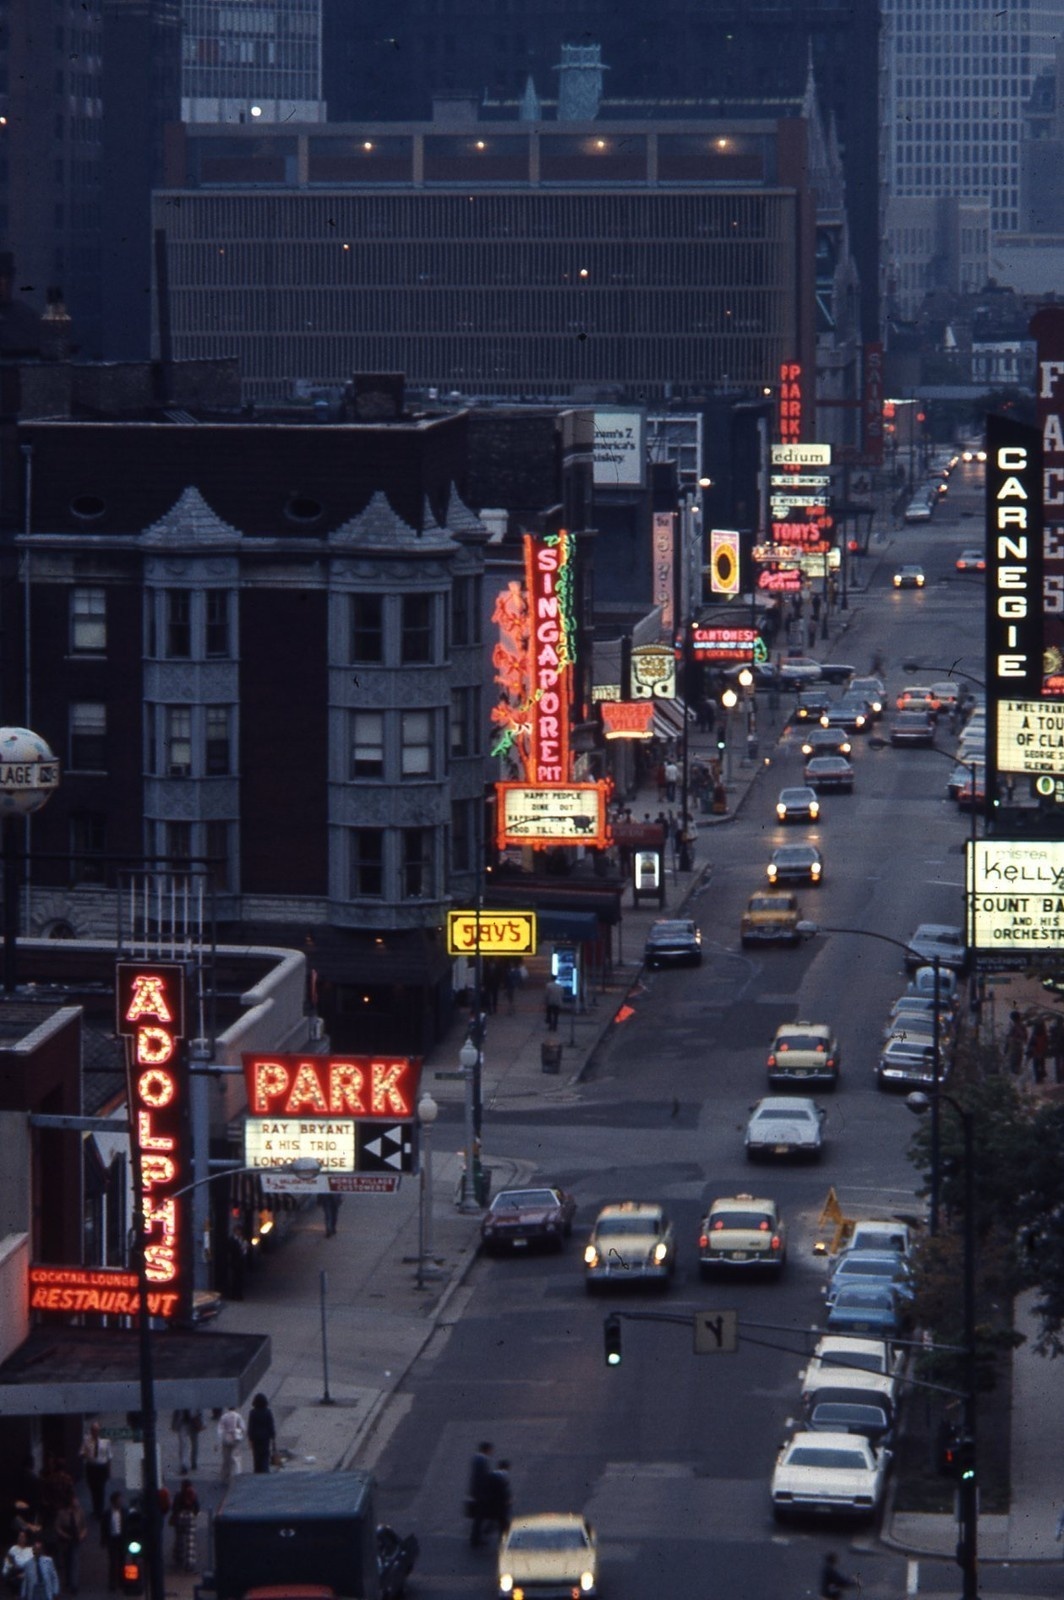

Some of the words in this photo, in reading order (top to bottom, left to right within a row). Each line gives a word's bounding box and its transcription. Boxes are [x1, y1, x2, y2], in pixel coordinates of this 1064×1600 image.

[1039, 361, 1064, 613] FACES
[997, 447, 1028, 677] CARNEGIE
[538, 548, 558, 762] SINGAPORE
[1016, 703, 1035, 712] MEL
[1022, 716, 1030, 729] A
[1016, 733, 1034, 746] OF
[1024, 750, 1055, 759] GEORGE
[1024, 762, 1054, 771] GLENDA
[538, 766, 561, 781] PIT
[553, 792, 581, 800] PEOPLE
[1013, 917, 1032, 926] AND
[1041, 917, 1060, 926] HIS
[254, 1062, 409, 1113] PARK
[262, 1124, 288, 1134] RAY
[301, 1124, 351, 1134] BRYANT
[265, 1140, 273, 1150] &
[279, 1140, 299, 1150] HIS
[310, 1141, 337, 1151] TRIO
[31, 1270, 87, 1284] COCKTAIL
